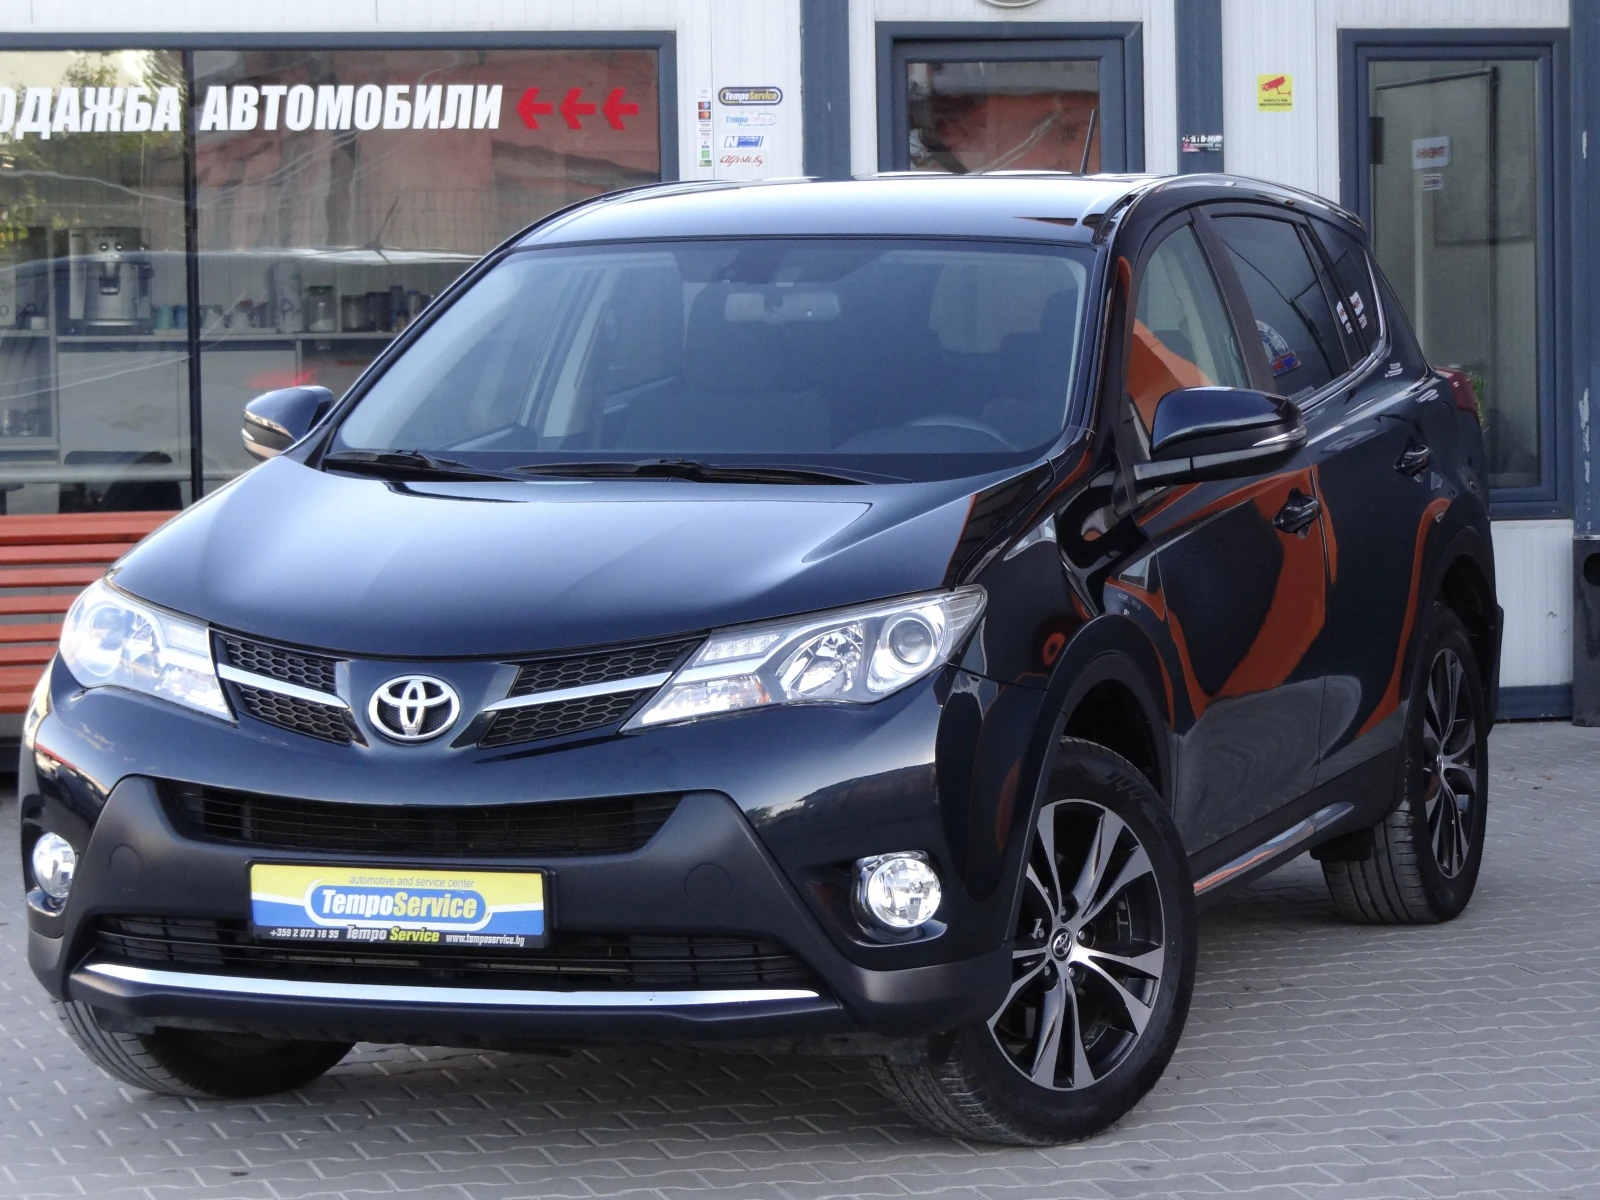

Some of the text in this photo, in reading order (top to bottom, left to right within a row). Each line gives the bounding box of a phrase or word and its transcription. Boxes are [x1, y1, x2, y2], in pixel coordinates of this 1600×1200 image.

[725, 91, 777, 104] TempoService
[200, 84, 503, 131] АВТОМОБИЛИ
[726, 116, 748, 126] Tempo
[349, 875, 475, 888] automotive and service center
[322, 889, 477, 918] TempoService
[269, 925, 525, 946] +359 2 973 16 35 Tempo Service www.temposervice.bg
